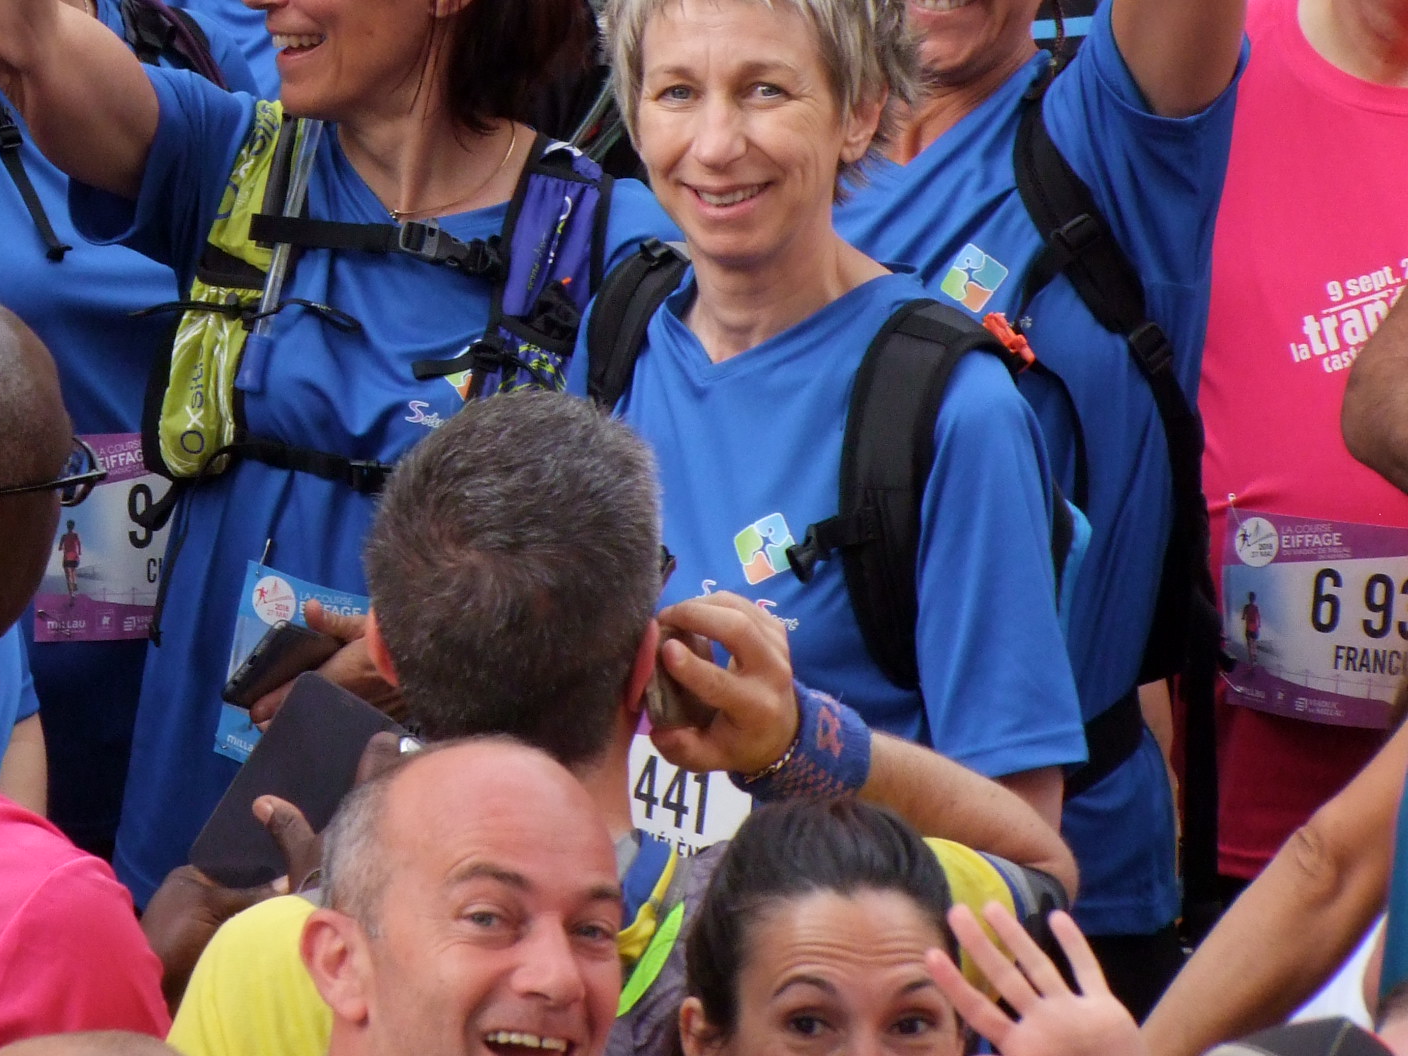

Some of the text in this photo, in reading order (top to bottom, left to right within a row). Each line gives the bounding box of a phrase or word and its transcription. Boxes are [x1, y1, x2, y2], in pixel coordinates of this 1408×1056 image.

[1327, 280, 1344, 302] 9
[1345, 265, 1401, 297] sept.
[1290, 342, 1311, 363] la
[1323, 346, 1362, 373] cast
[128, 483, 153, 550] 9
[1281, 523, 1334, 535] LA COURSE
[1281, 532, 1344, 549] EIFFAGE
[298, 602, 362, 617] EFAGE
[1312, 567, 1343, 634] 6
[1334, 644, 1408, 677] FRANC
[633, 754, 711, 835] 441
